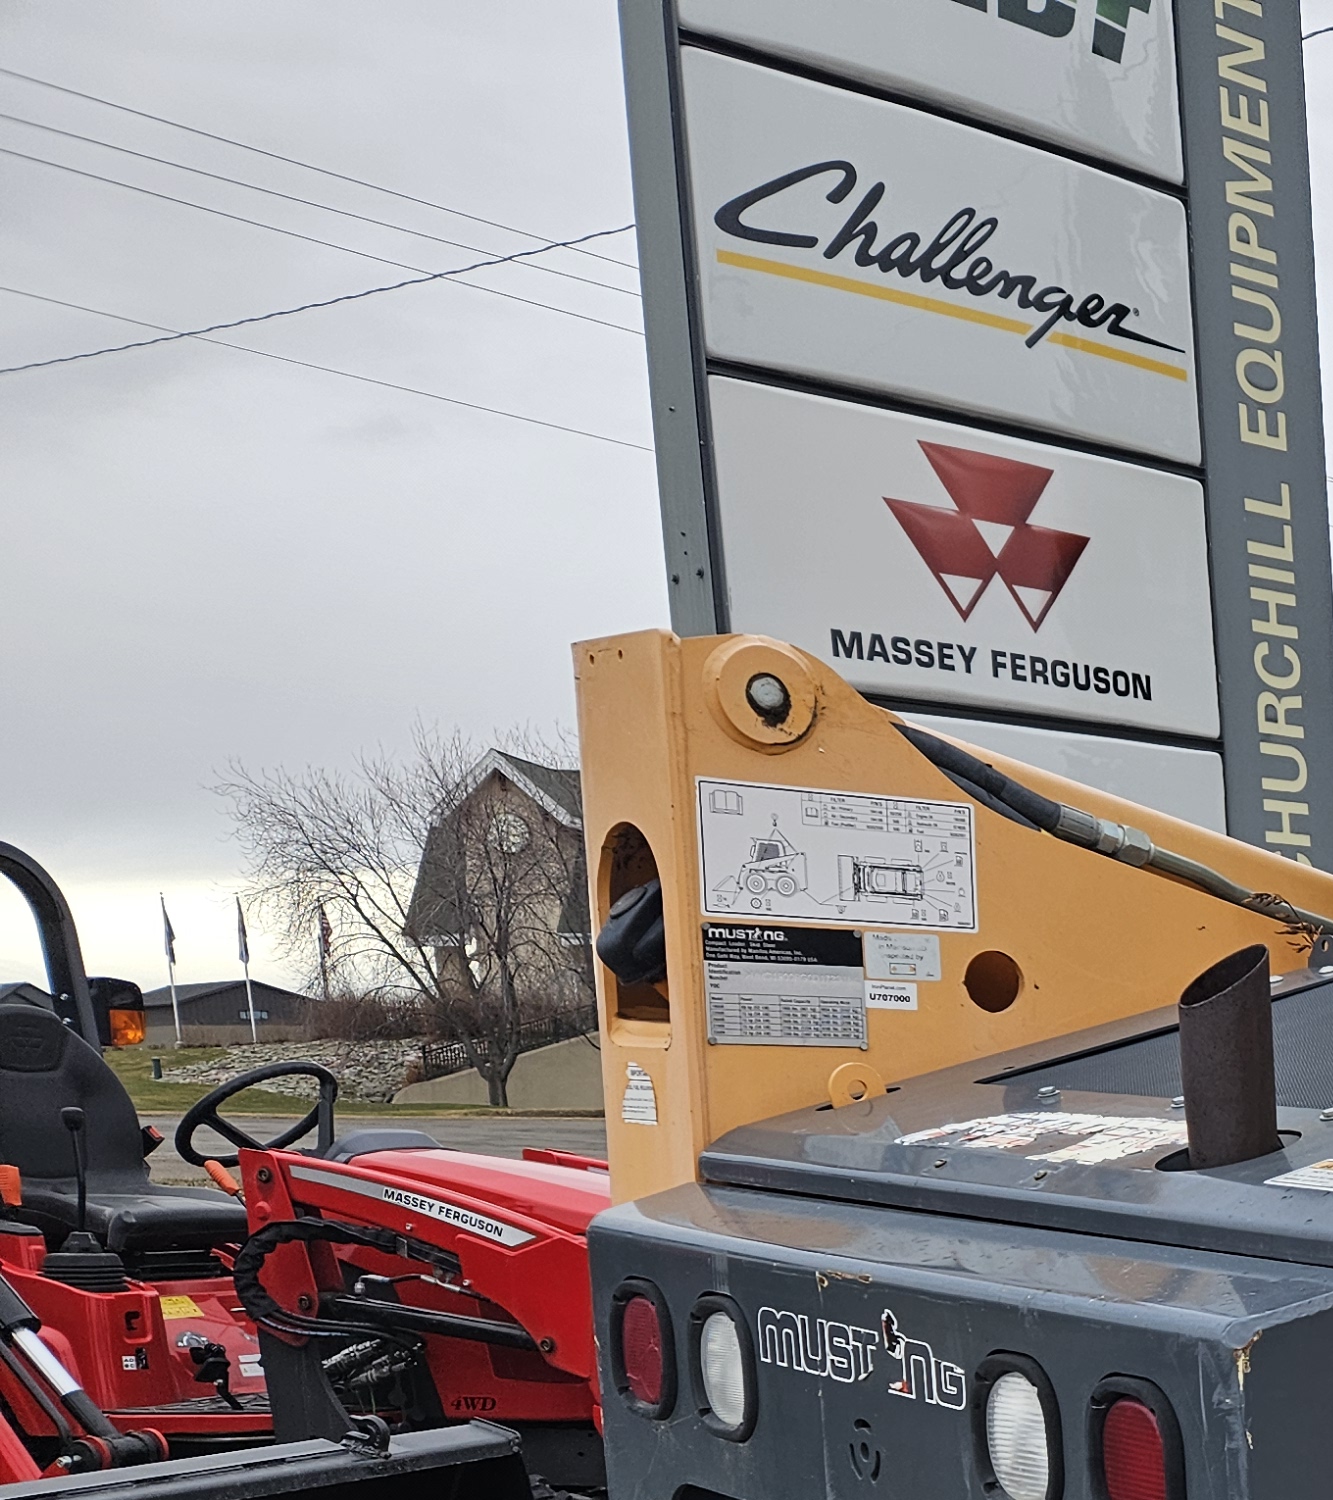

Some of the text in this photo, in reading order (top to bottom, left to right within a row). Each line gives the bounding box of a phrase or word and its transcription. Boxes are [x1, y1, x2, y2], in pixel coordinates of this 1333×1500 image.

[714, 160, 1187, 348] Challenger
[830, 628, 1153, 702] MASSEY FERGUSON
[1243, 482, 1312, 867] HURCHILL
[869, 992, 911, 1003] U707000
[384, 1188, 504, 1237] MASSEY FERGUSON
[757, 1307, 966, 1410] MUSTNG
[451, 1396, 497, 1411] 4WD
